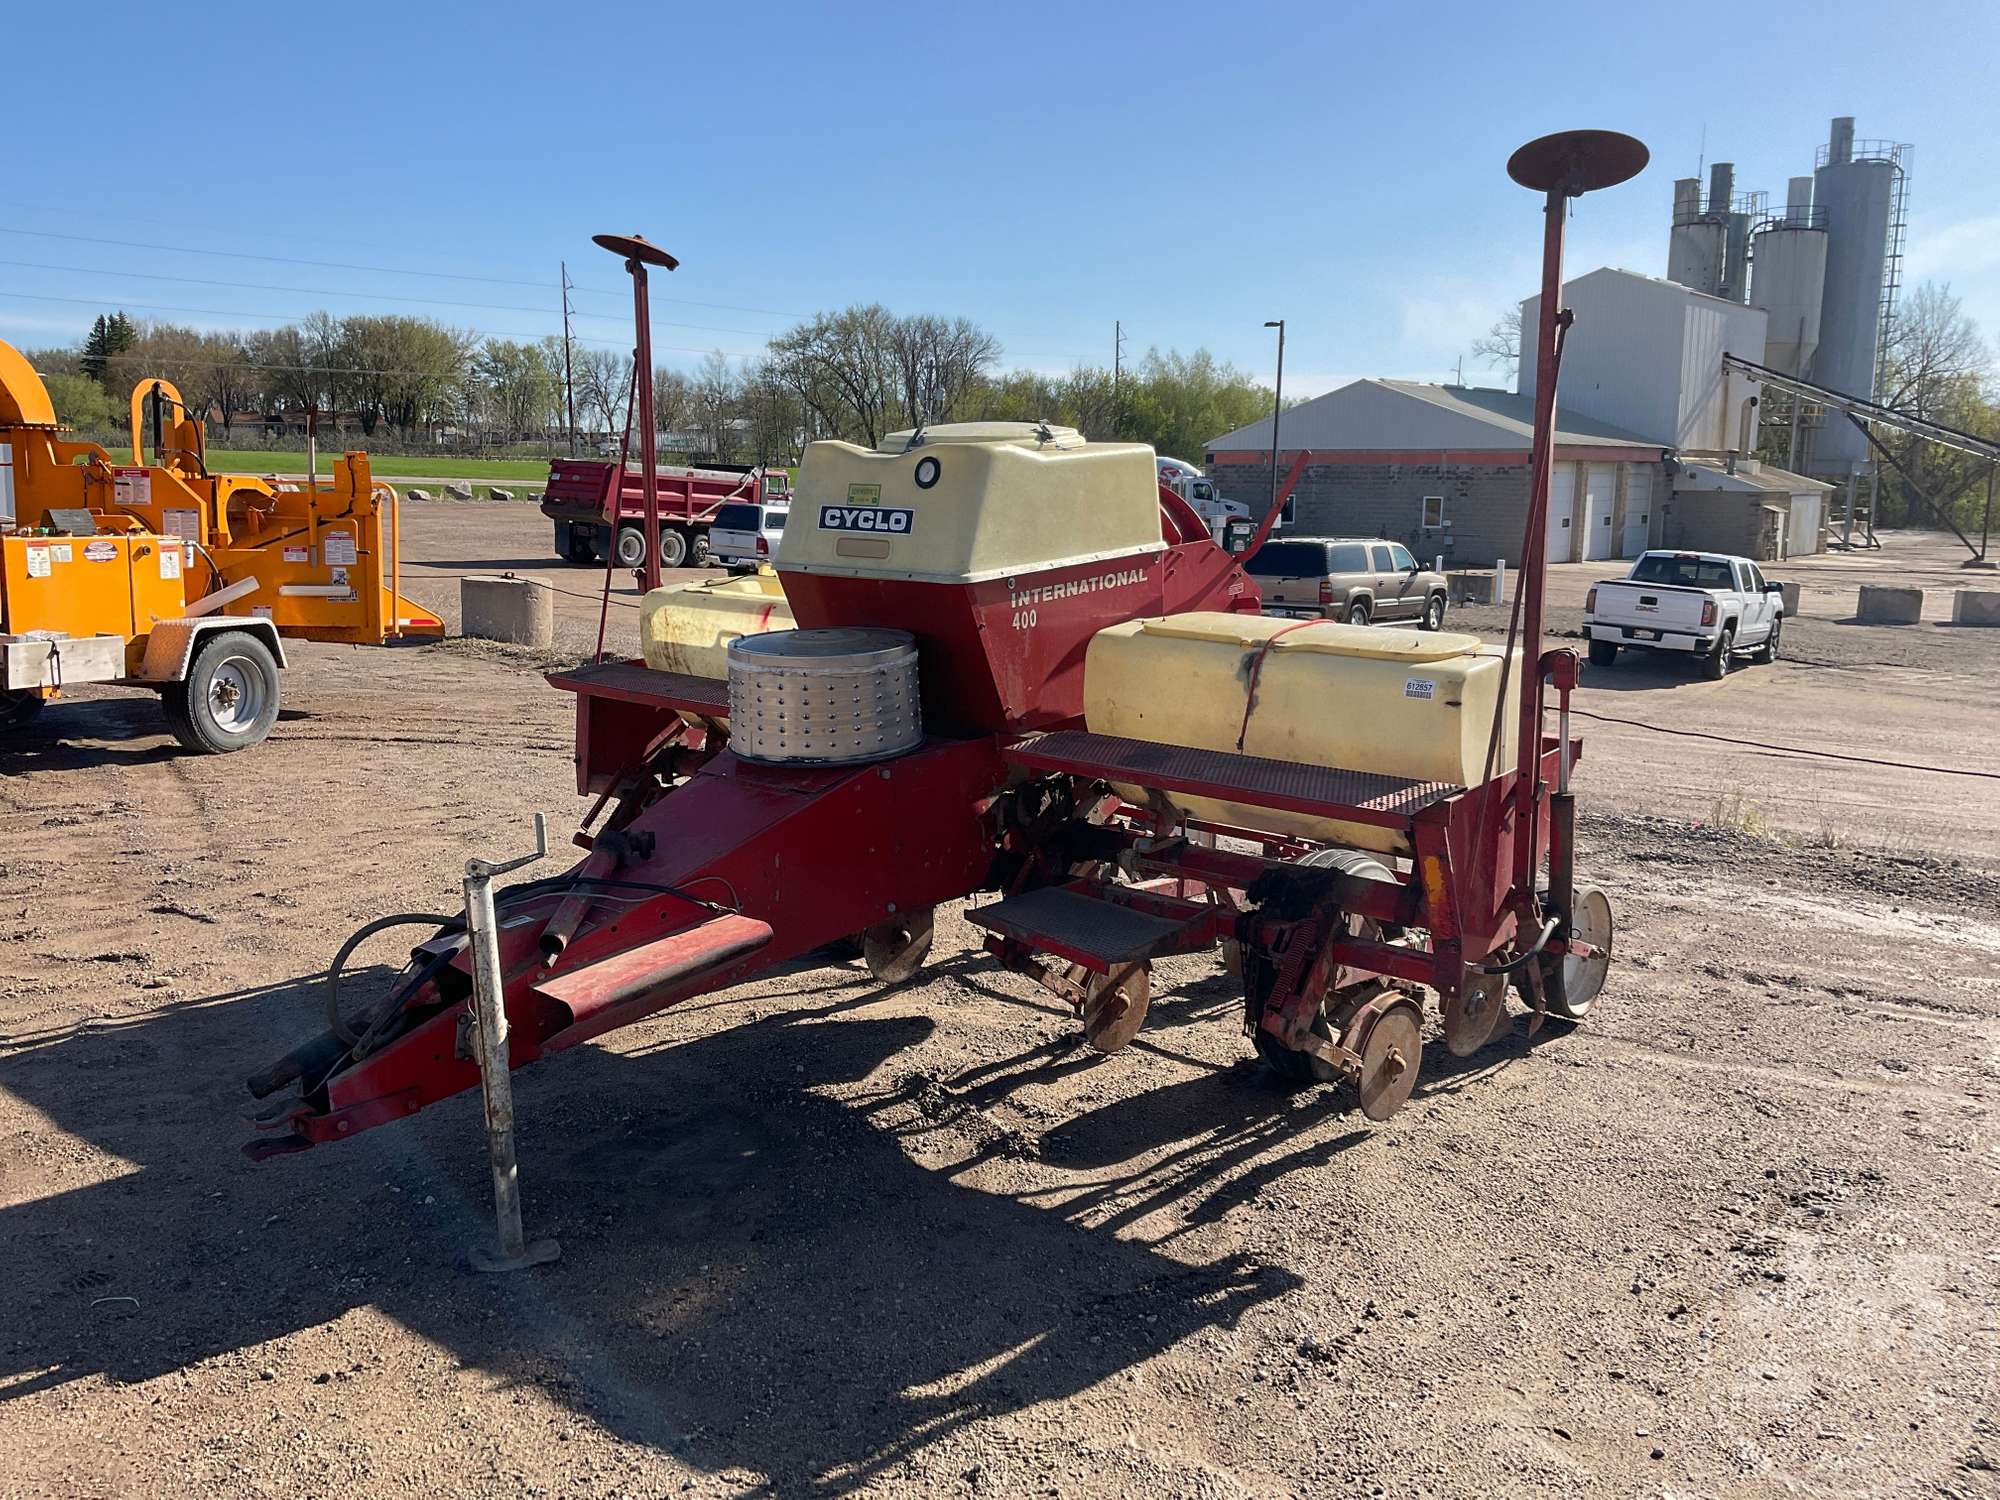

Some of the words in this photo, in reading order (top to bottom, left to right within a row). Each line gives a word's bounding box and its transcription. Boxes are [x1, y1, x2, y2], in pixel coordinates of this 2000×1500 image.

[825, 509, 907, 531] CYCLO
[1011, 568, 1148, 608] INTERNATIONAL
[1012, 608, 1037, 631] 400
